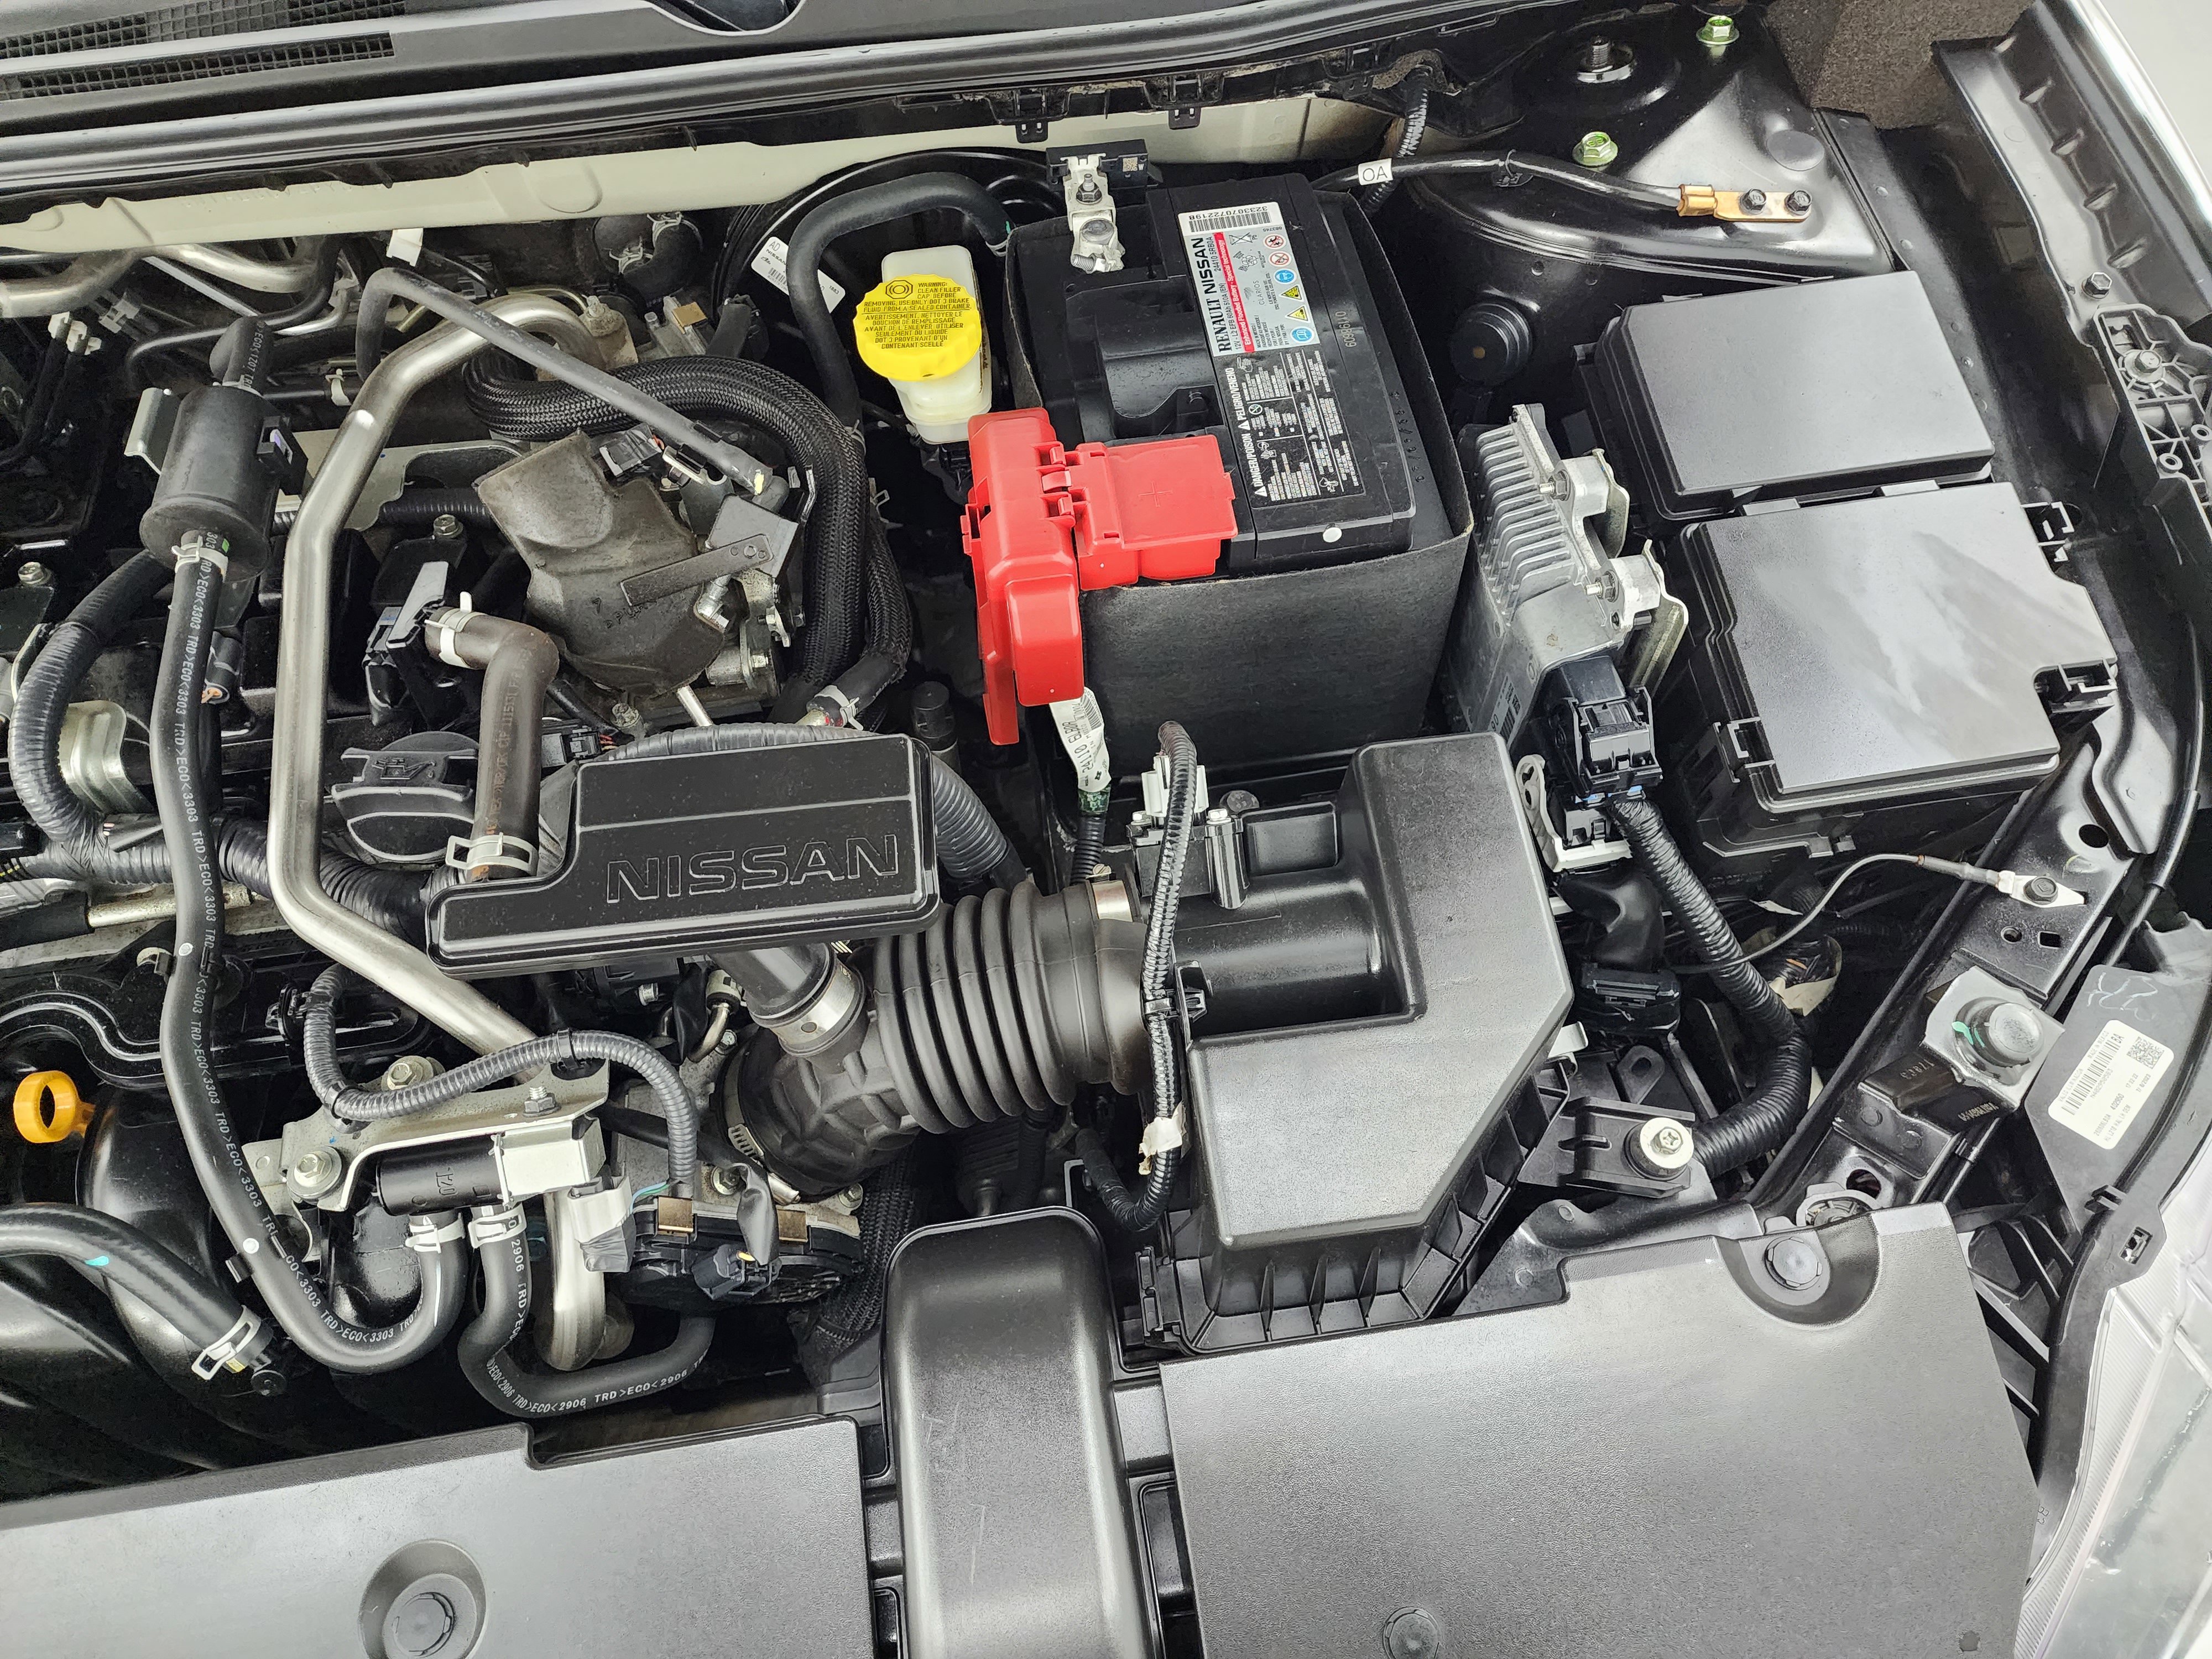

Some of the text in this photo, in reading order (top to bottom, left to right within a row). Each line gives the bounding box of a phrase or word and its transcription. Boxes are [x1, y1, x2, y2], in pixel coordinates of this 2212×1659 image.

[769, 241, 781, 252] AD
[1217, 239, 1230, 263] technology
[1211, 255, 1221, 272] 24410
[1223, 264, 1235, 281] Special
[1191, 237, 1232, 353] RENAULT NISSAN
[1218, 282, 1228, 293] (EN)
[1229, 284, 1240, 301] Battery
[1253, 280, 1265, 305] CLARIOS
[1221, 293, 1229, 305] 510A
[1224, 306, 1233, 319] 60Ah
[1233, 302, 1244, 321] Flooded
[1228, 319, 1236, 329] EFB
[1239, 321, 1251, 345] Enhanced
[1233, 340, 1241, 349] 12V
[1224, 367, 1264, 487] DANGER/POISON PELIGRO/VENENO
[190, 559, 212, 630] RD>ECO<3303
[1072, 743, 1095, 774] 24110
[606, 834, 899, 904] NISSAN
[2110, 1031, 2124, 1044] BA
